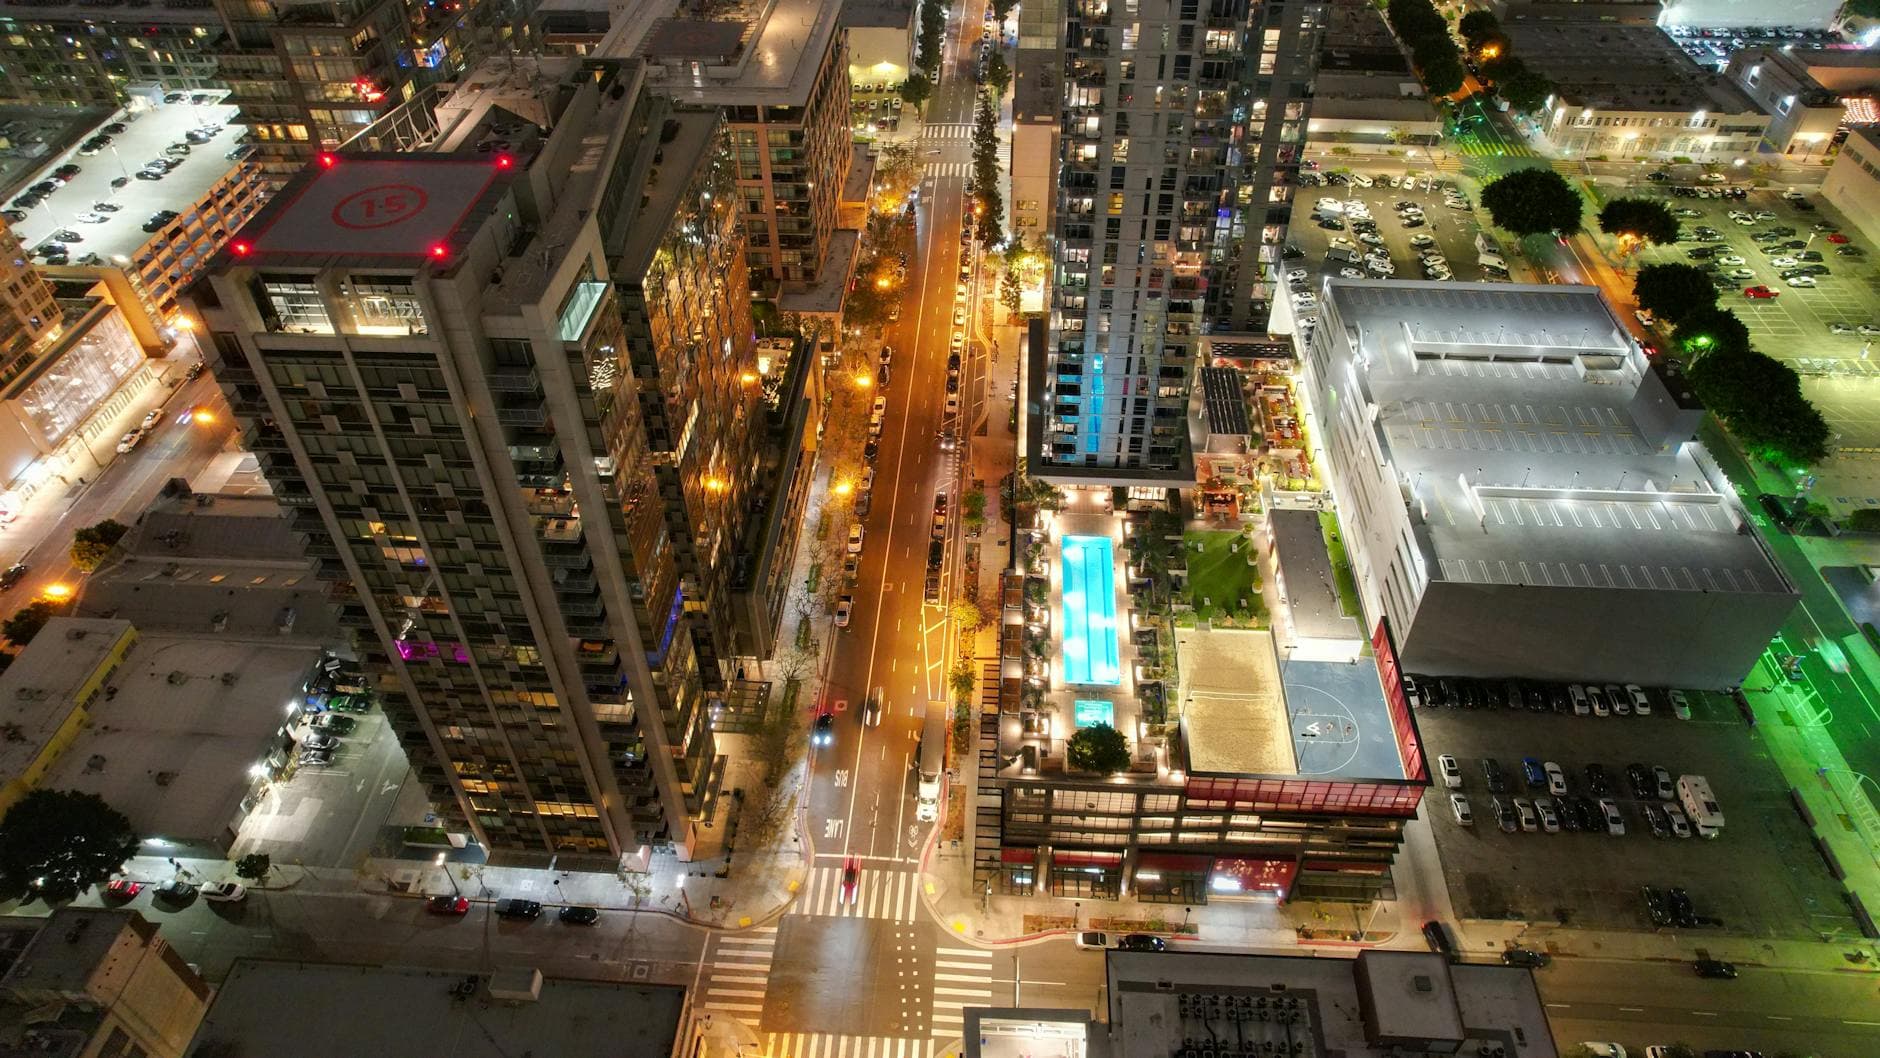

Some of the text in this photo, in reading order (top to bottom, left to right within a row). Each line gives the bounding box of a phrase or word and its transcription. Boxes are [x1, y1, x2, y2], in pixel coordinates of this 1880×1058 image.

[360, 192, 407, 218] 15
[834, 769, 849, 787] BUS
[824, 818, 844, 839] LANE
